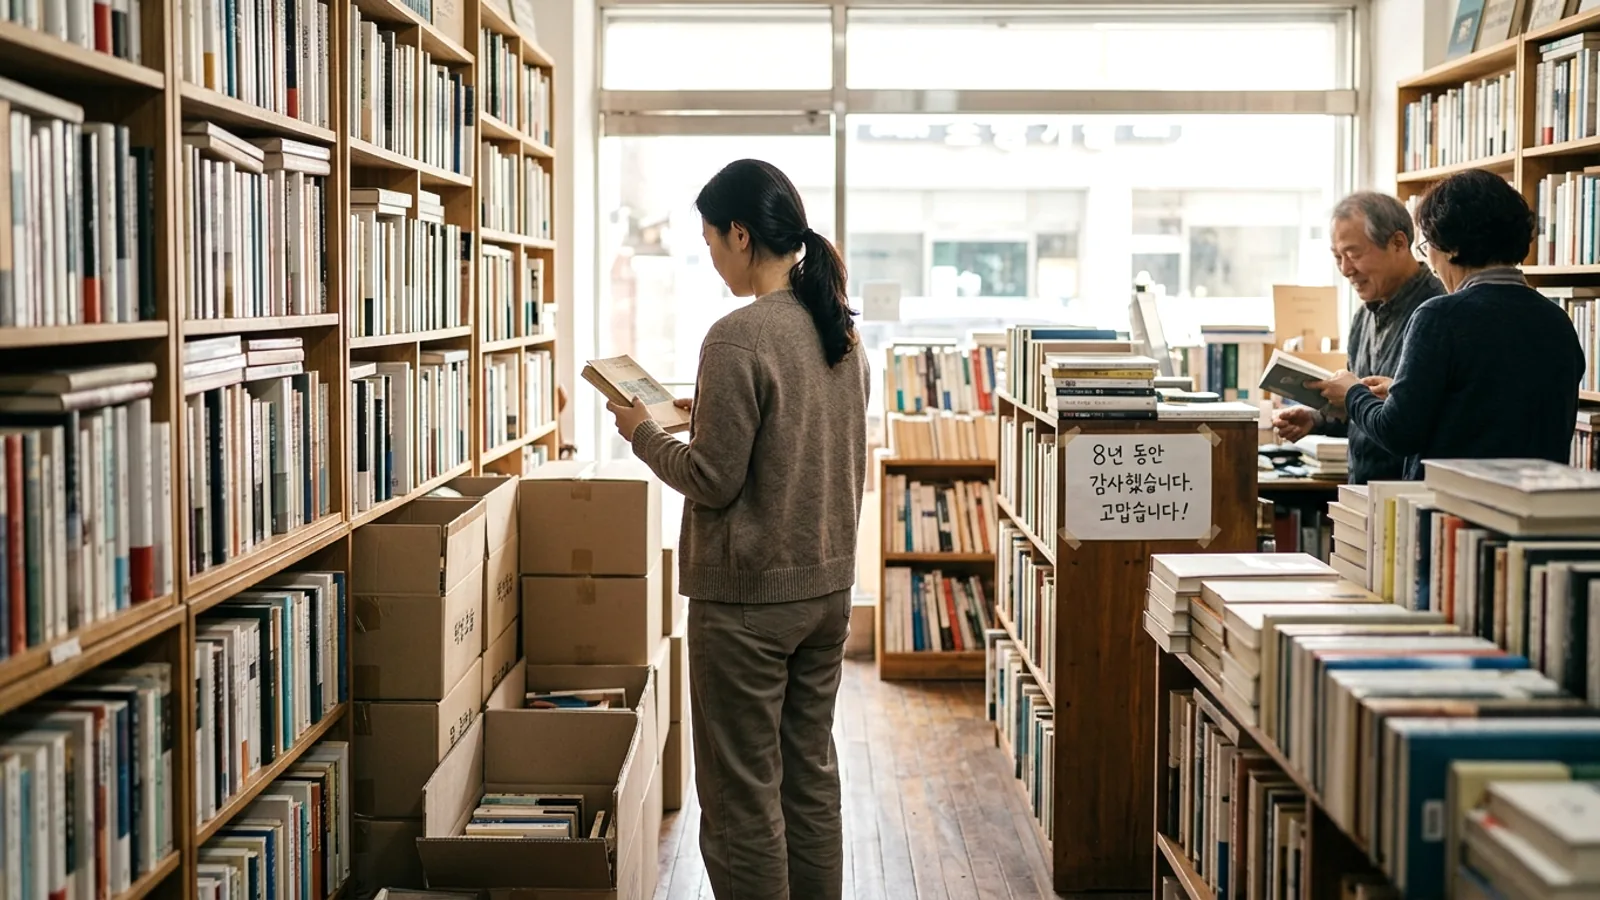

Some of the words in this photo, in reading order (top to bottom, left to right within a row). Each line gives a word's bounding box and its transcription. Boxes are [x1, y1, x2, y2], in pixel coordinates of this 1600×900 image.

[1093, 443, 1124, 466] 8년
[1133, 443, 1165, 466] 동안
[1089, 472, 1193, 496] 감사했습니다.
[1100, 501, 1189, 524] 고맙습니다!
